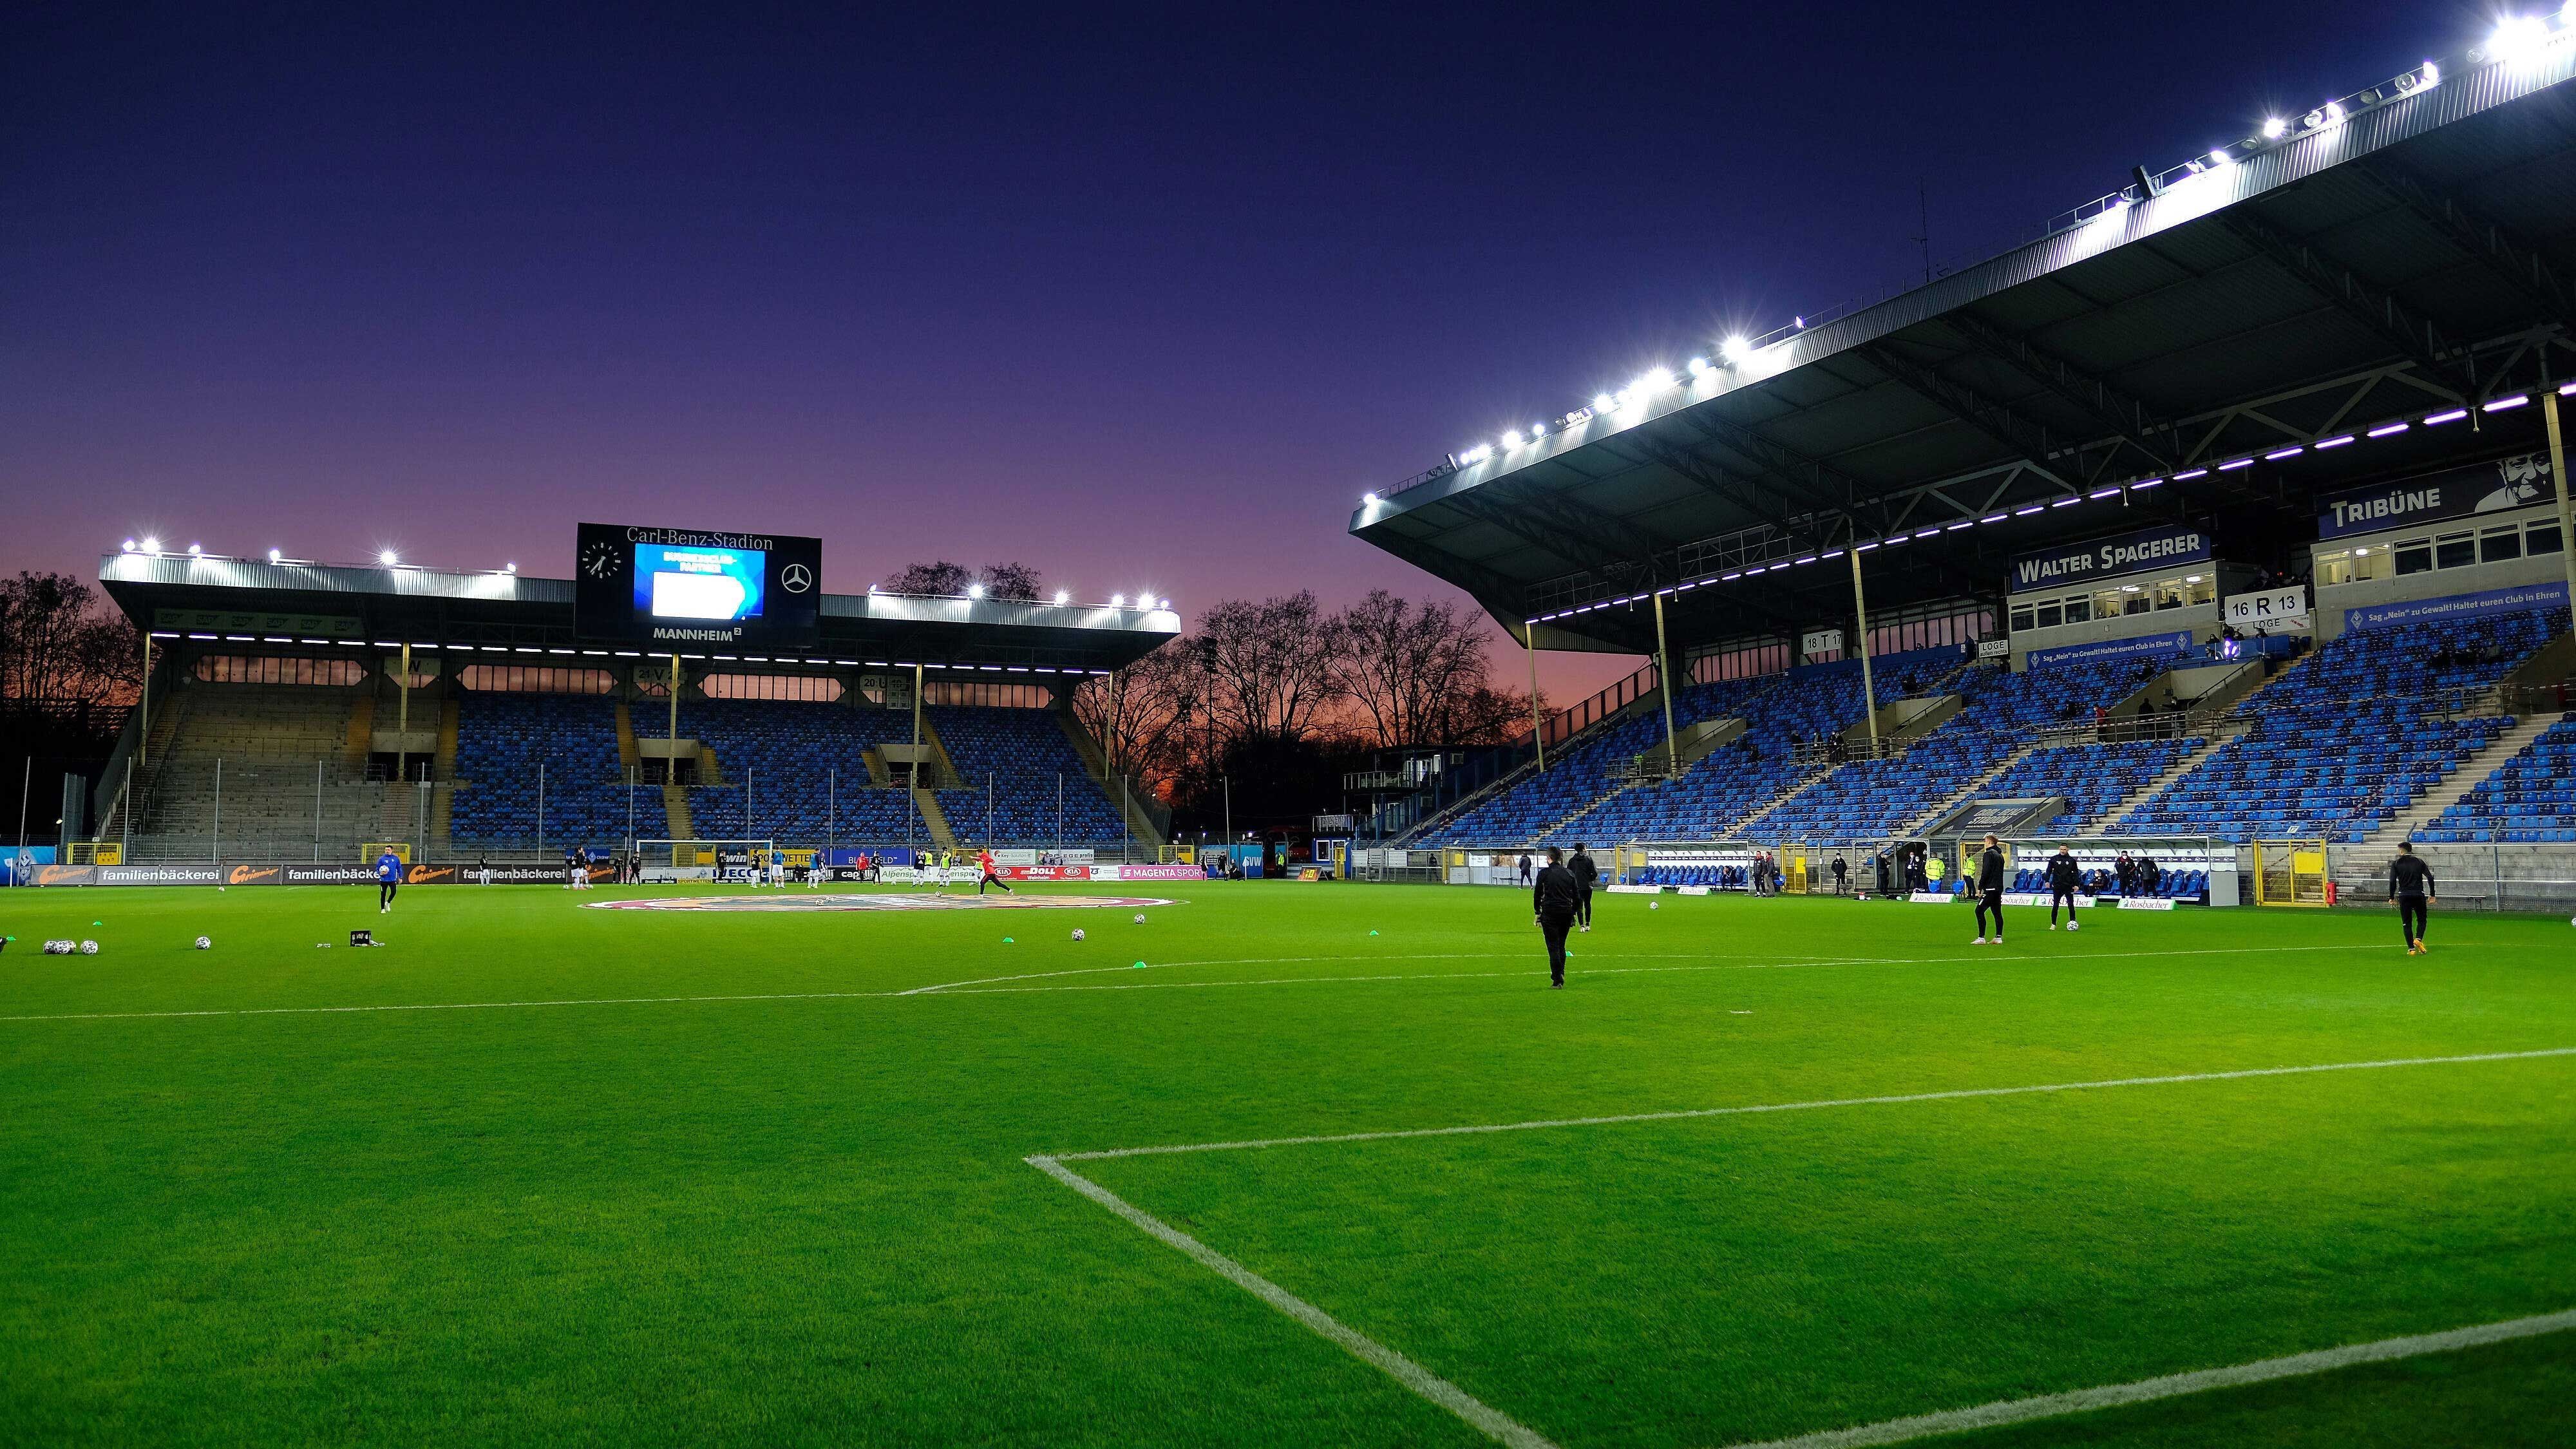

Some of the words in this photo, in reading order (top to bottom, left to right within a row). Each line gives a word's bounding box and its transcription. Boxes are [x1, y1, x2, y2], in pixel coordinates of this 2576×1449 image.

[2330, 488, 2441, 527] TRIBÜNE
[627, 527, 773, 550] Carl-Benz-Stadion
[2019, 554, 2092, 583] WALTER
[2101, 533, 2201, 569] SPAGERER
[2233, 601, 2249, 616] 16
[2256, 597, 2271, 616] R
[2278, 595, 2295, 610] 13
[2453, 600, 2478, 611] Haltet
[2479, 598, 2503, 607] euren
[2505, 594, 2523, 604] Club
[2525, 593, 2533, 601] in
[2535, 591, 2560, 600] Ehren
[2253, 618, 2280, 629] LOGE
[653, 627, 733, 641] MANNHEIM
[1808, 638, 1817, 649] 18
[1821, 634, 1828, 648] T
[1833, 634, 1841, 645] 17
[1982, 641, 2004, 651] LOGE
[654, 668, 665, 680] V
[864, 678, 875, 687] 20
[103, 869, 220, 881] familienbäckerei
[288, 869, 381, 880] familienbäcke
[1133, 869, 1176, 877] MAGENTA
[1177, 869, 1200, 877] SPOR
[2001, 896, 2031, 905] osbacher
[2130, 899, 2169, 909] Rosbacher
